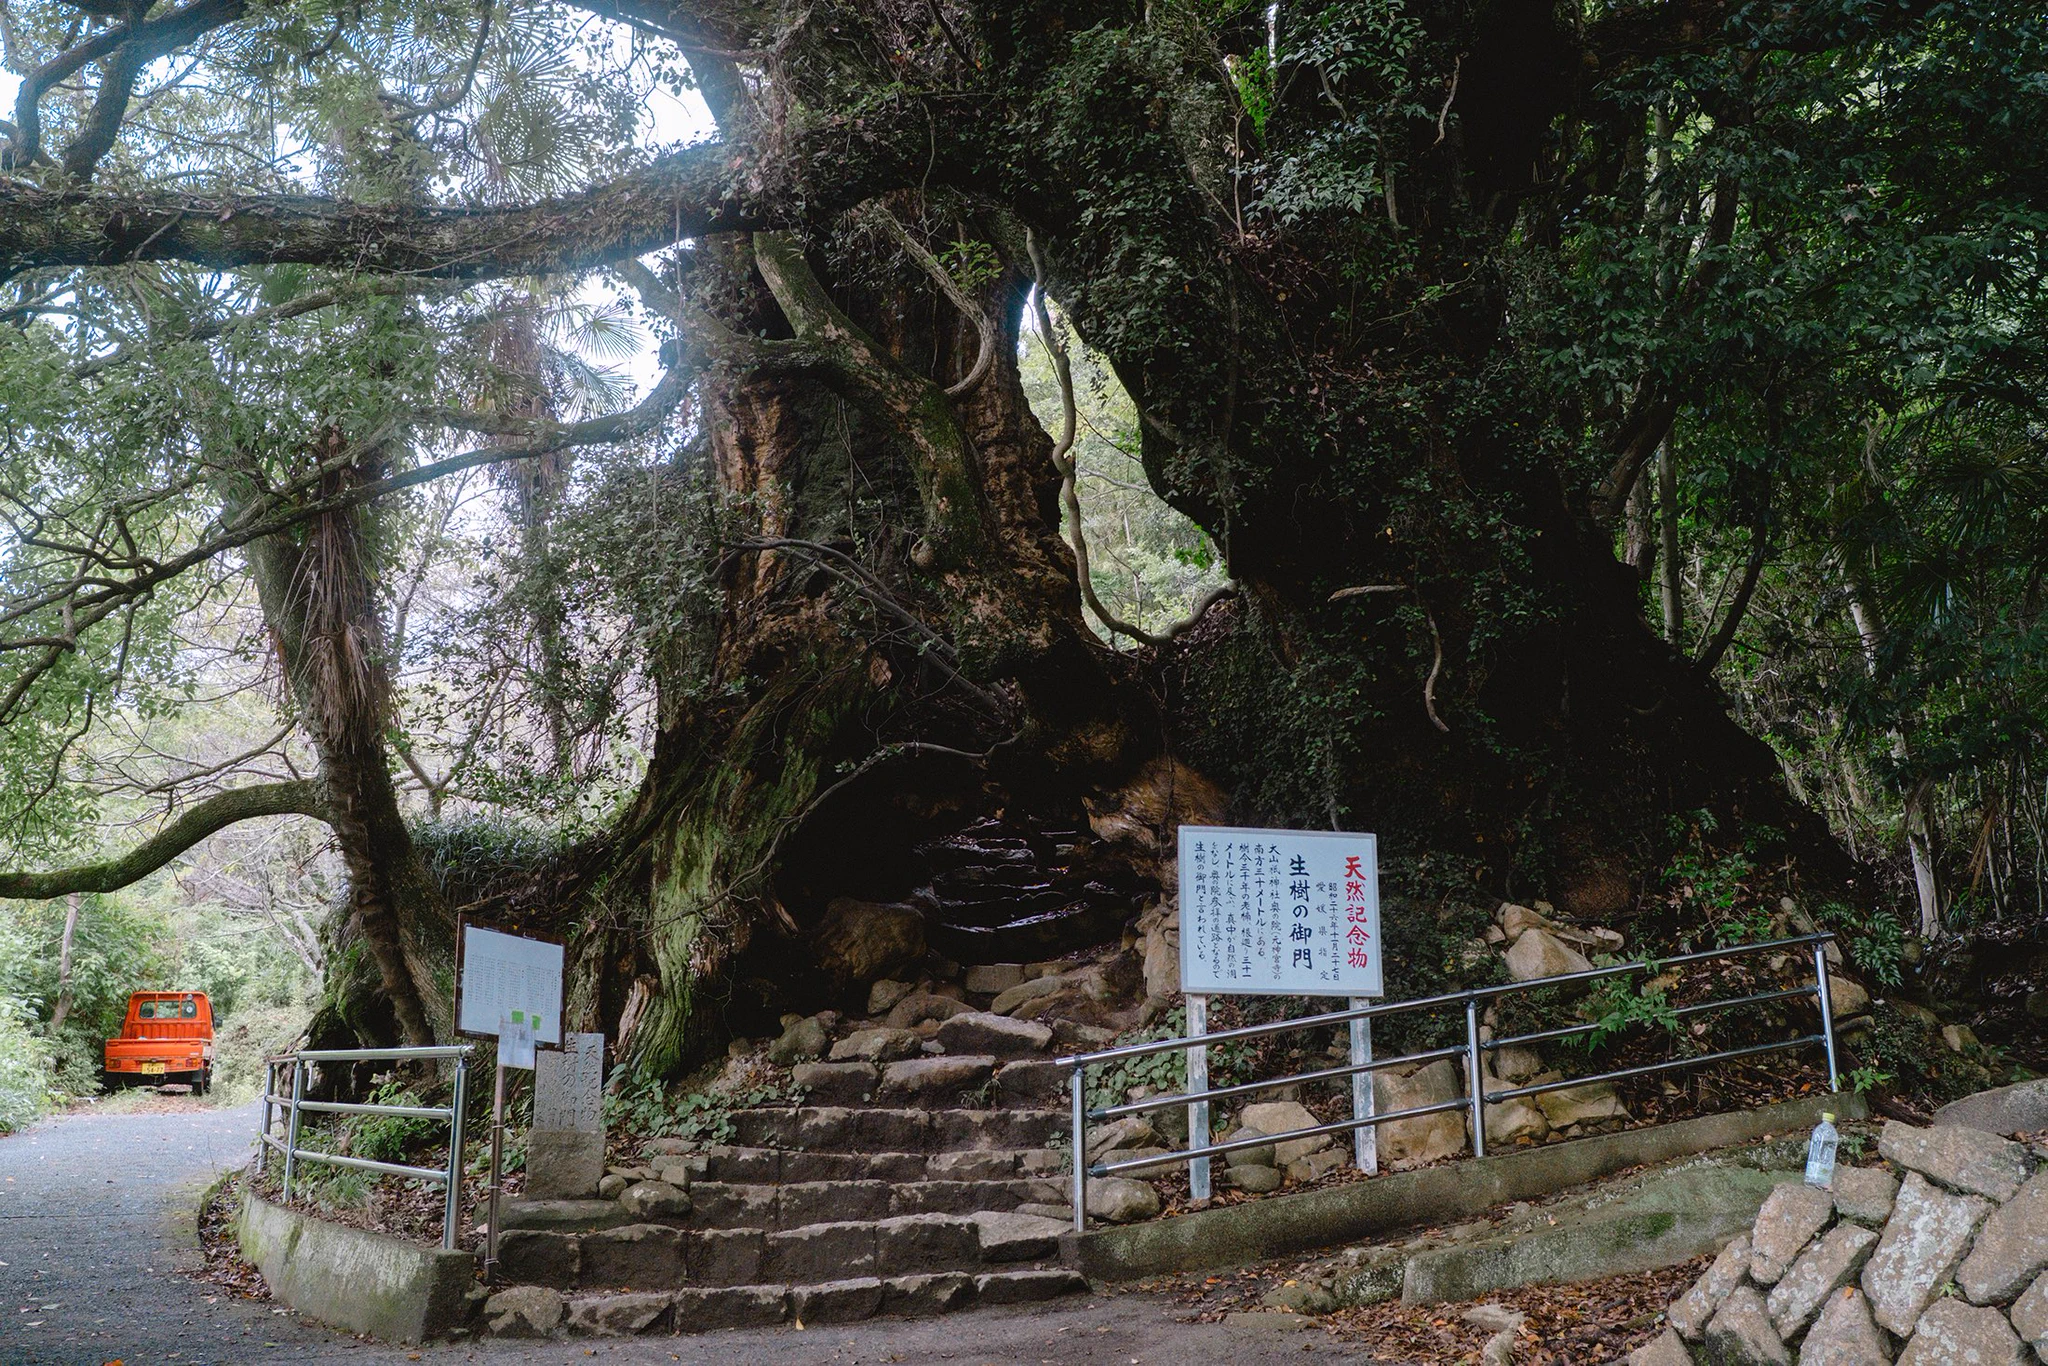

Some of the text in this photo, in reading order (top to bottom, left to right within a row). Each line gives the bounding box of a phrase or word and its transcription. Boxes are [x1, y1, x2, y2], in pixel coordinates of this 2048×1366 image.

[1289, 854, 1312, 970] 生樹の御門
[1328, 882, 1340, 981] 昭和二十六年十一月二十七日
[1344, 856, 1370, 969] 天然記念物
